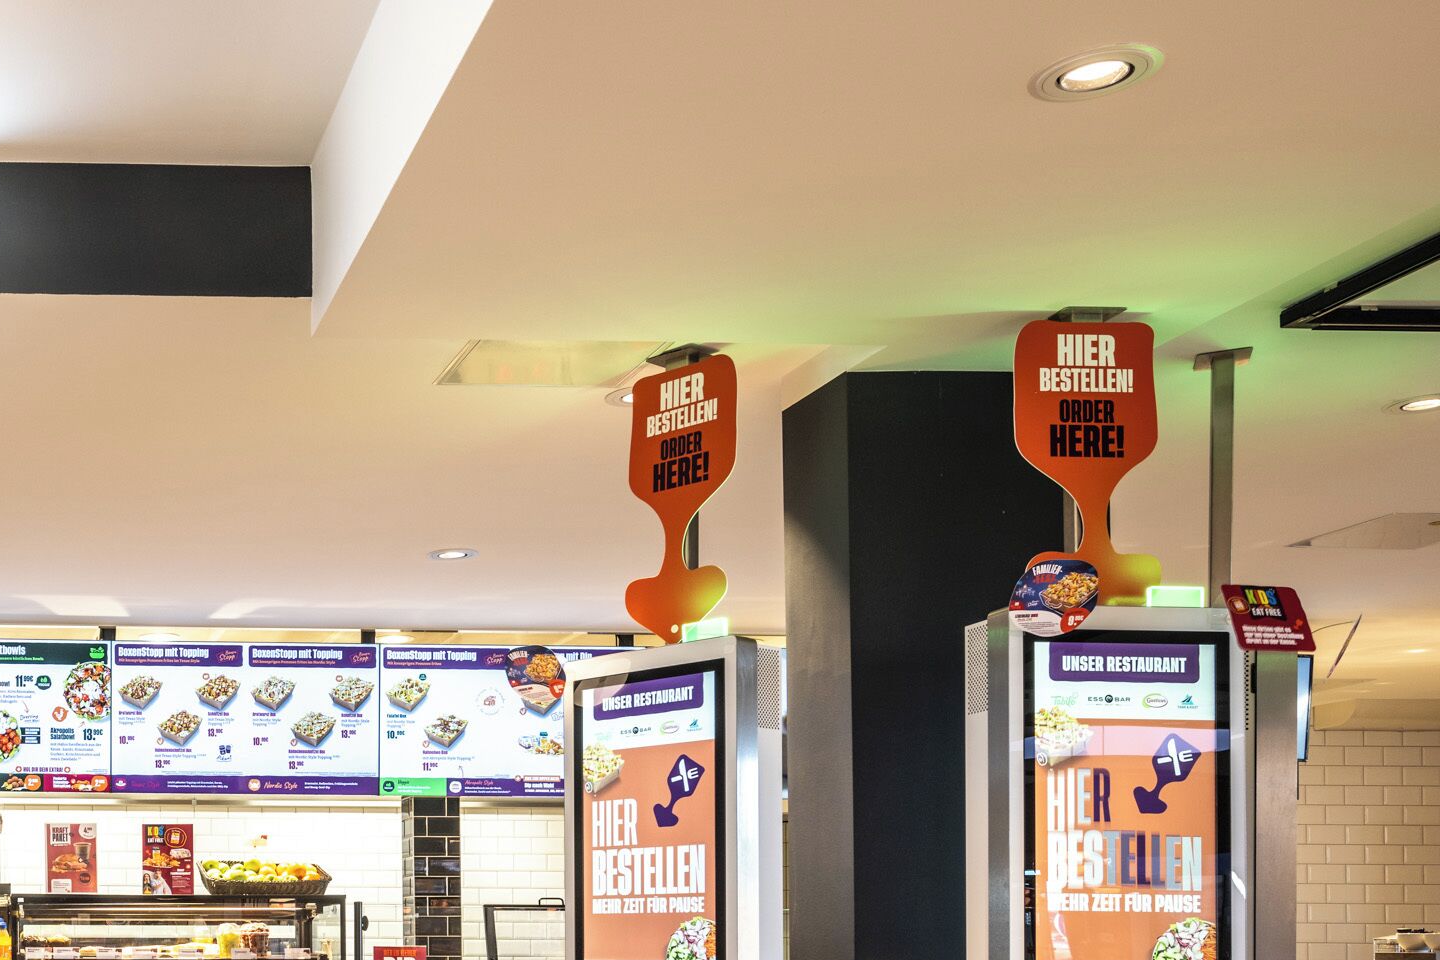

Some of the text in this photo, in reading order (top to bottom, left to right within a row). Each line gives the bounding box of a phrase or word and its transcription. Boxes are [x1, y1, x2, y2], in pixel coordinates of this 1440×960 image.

[1057, 334, 1116, 367] HIER
[1040, 367, 1134, 393] BESTELLEN!
[660, 372, 704, 412] HIER
[646, 398, 718, 438] BESTELLEN!
[1059, 399, 1114, 423] ORDER
[660, 431, 702, 460] ORDER
[1050, 424, 1124, 458] HERE!
[652, 451, 709, 493] HERE!
[1244, 588, 1278, 605] KIDS
[1251, 607, 1282, 617] EAT FREE
[118, 647, 209, 659] BoxenStopp mit Topping
[252, 648, 343, 660] BoxenStopp mit Topping
[387, 650, 477, 662] BoxenStopp mit Topping
[1062, 655, 1187, 673] UNSER RESTAURANT
[16, 675, 33, 687] 11.99€
[602, 685, 694, 712] UNSER RESTAURANT
[83, 729, 103, 740] 13.99€
[264, 781, 282, 789] Nordic
[284, 781, 298, 790] Style
[1047, 768, 1111, 832] HIER
[147, 826, 164, 836] KIDS
[592, 798, 638, 848] HIER
[52, 833, 68, 842] PAKET
[592, 844, 705, 896] BESTELLEN
[1047, 829, 1202, 891] BESTELLEN
[592, 896, 704, 914] MEHR ZEIT FÜR PAUSE
[1091, 893, 1122, 912] ZEIT
[1124, 892, 1152, 912] FÜR
[1155, 894, 1201, 913] PAUSE
